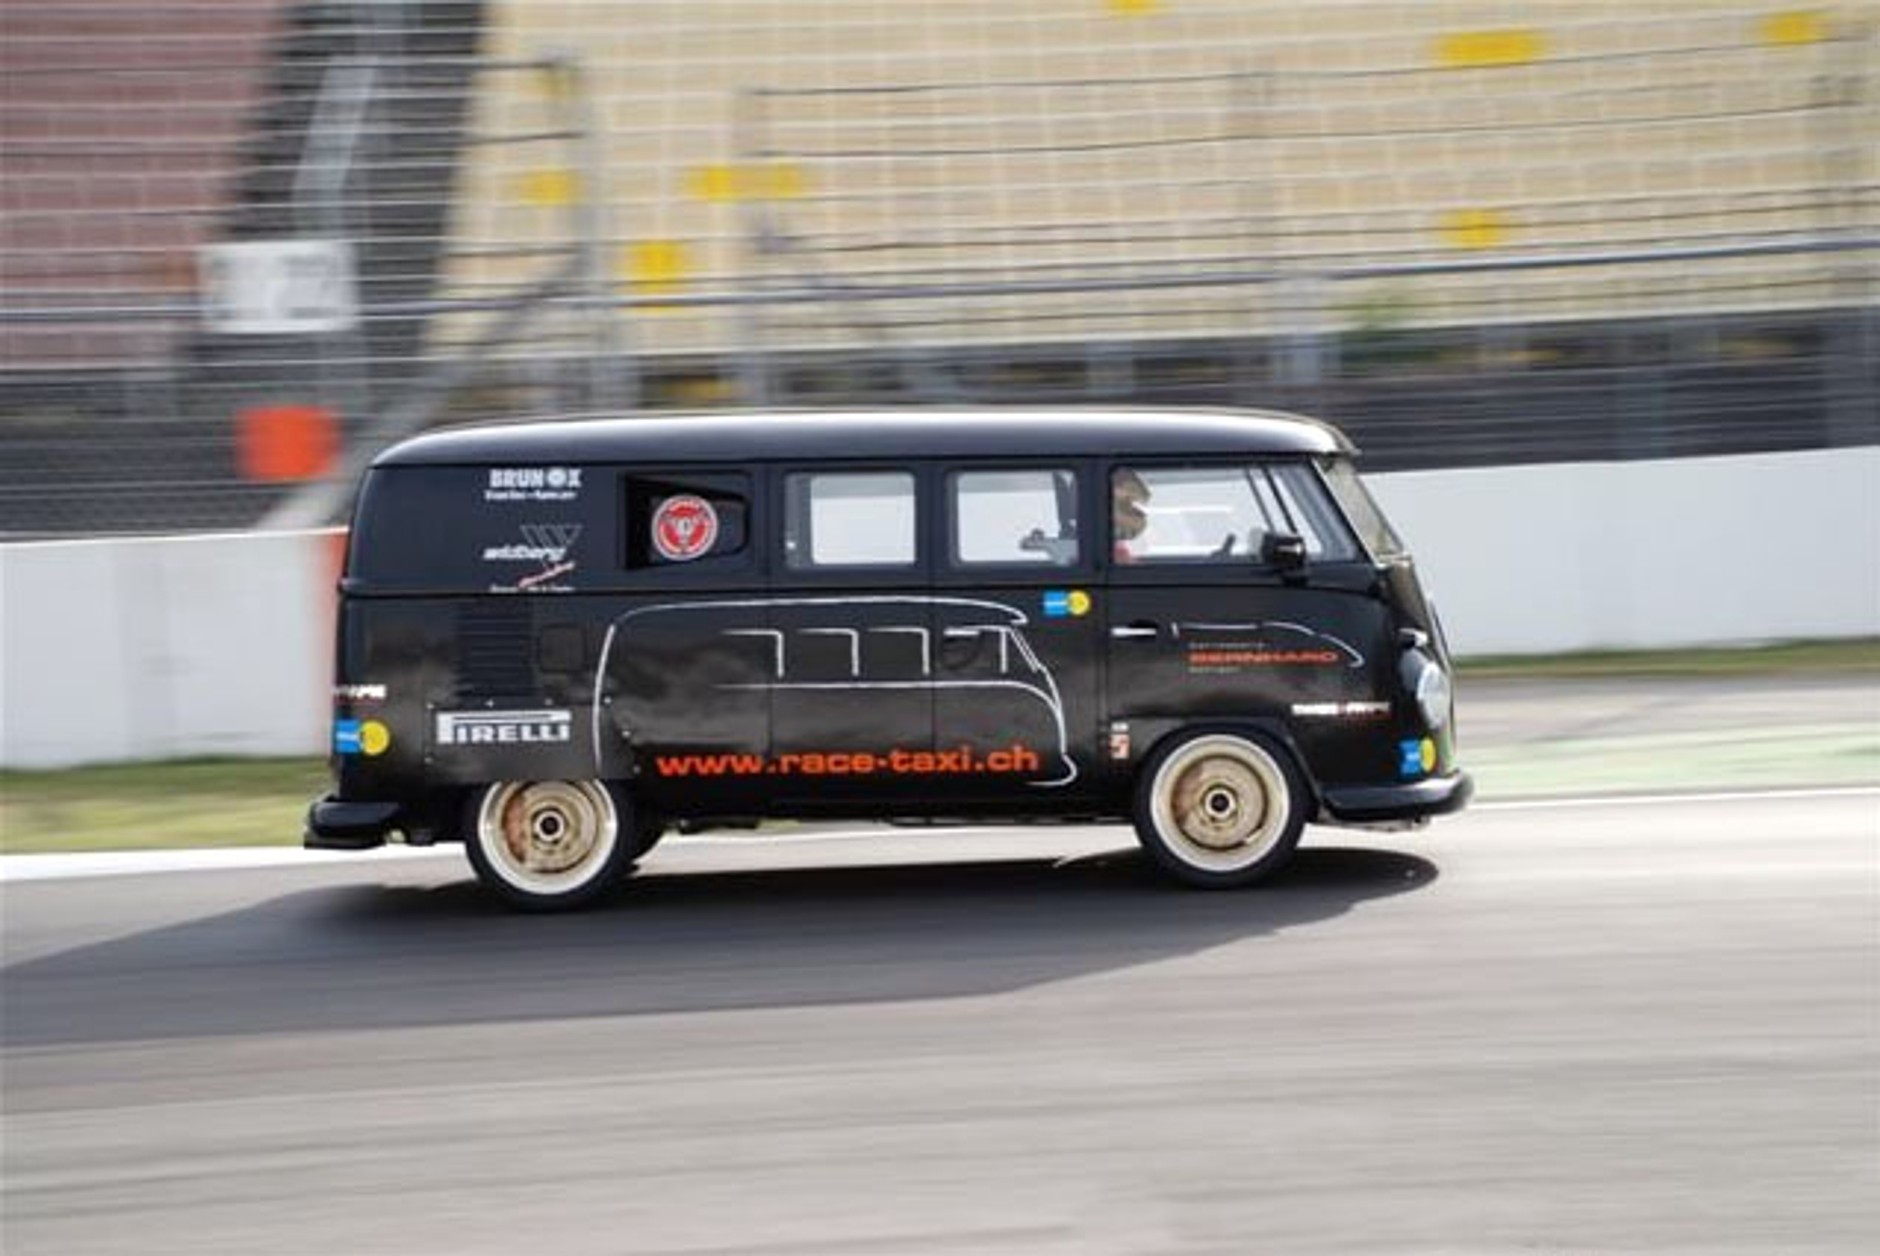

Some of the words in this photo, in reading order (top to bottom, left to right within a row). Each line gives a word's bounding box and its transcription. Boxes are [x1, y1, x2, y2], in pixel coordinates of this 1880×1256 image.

[489, 468, 582, 488] BRUNOX
[436, 709, 572, 744] PIRELLI
[656, 745, 1039, 776] www.race-taxi.ch
